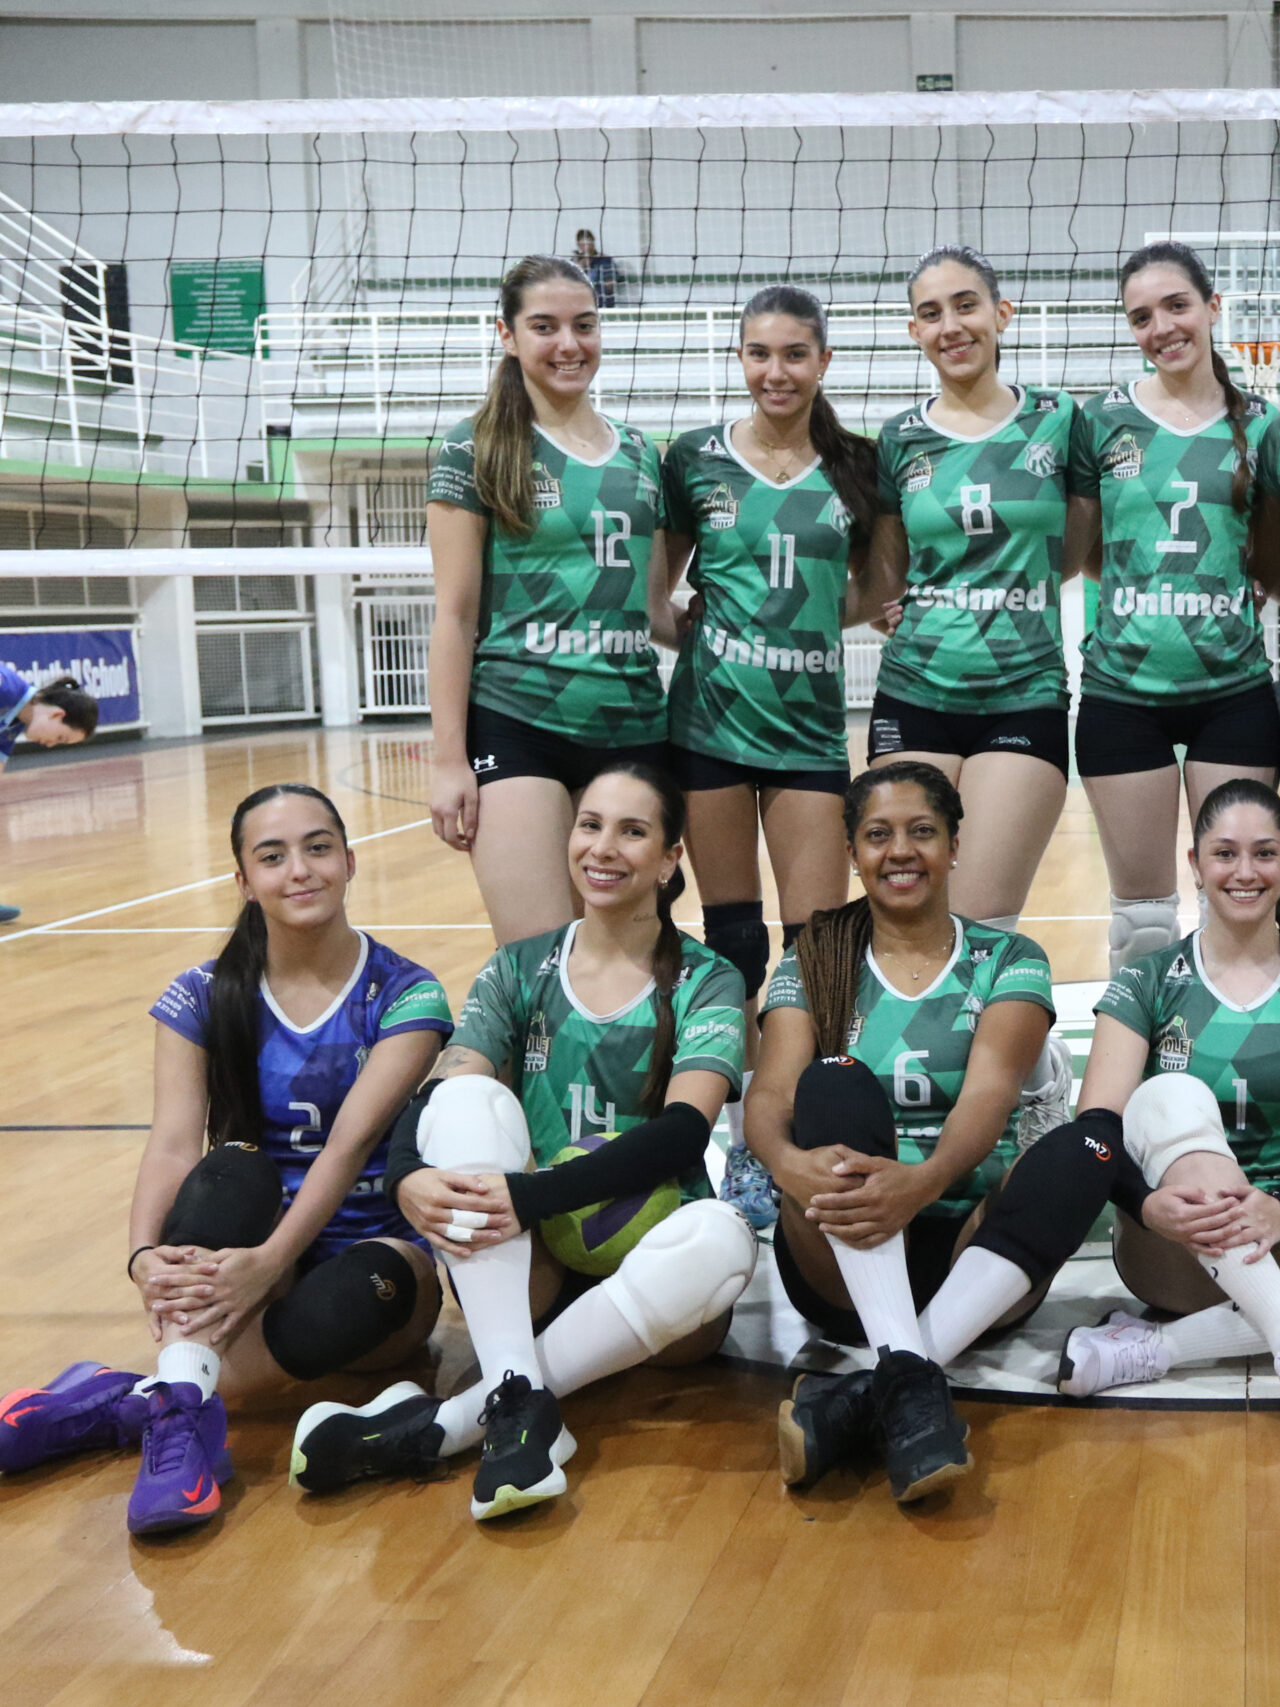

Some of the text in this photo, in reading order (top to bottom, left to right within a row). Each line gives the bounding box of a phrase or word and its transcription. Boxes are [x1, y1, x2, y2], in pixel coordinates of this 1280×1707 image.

[960, 483, 993, 536] 8
[590, 510, 632, 567] 12
[767, 533, 795, 589] 11
[904, 580, 1046, 611] Unimed
[703, 624, 841, 674] Unimed
[83, 656, 129, 699] School
[821, 1055, 849, 1065] TM7
[894, 1050, 931, 1107] 6
[288, 1102, 323, 1153] 2
[568, 1083, 615, 1144] 14
[1232, 1079, 1247, 1130] 1
[1085, 1136, 1108, 1154] TM7
